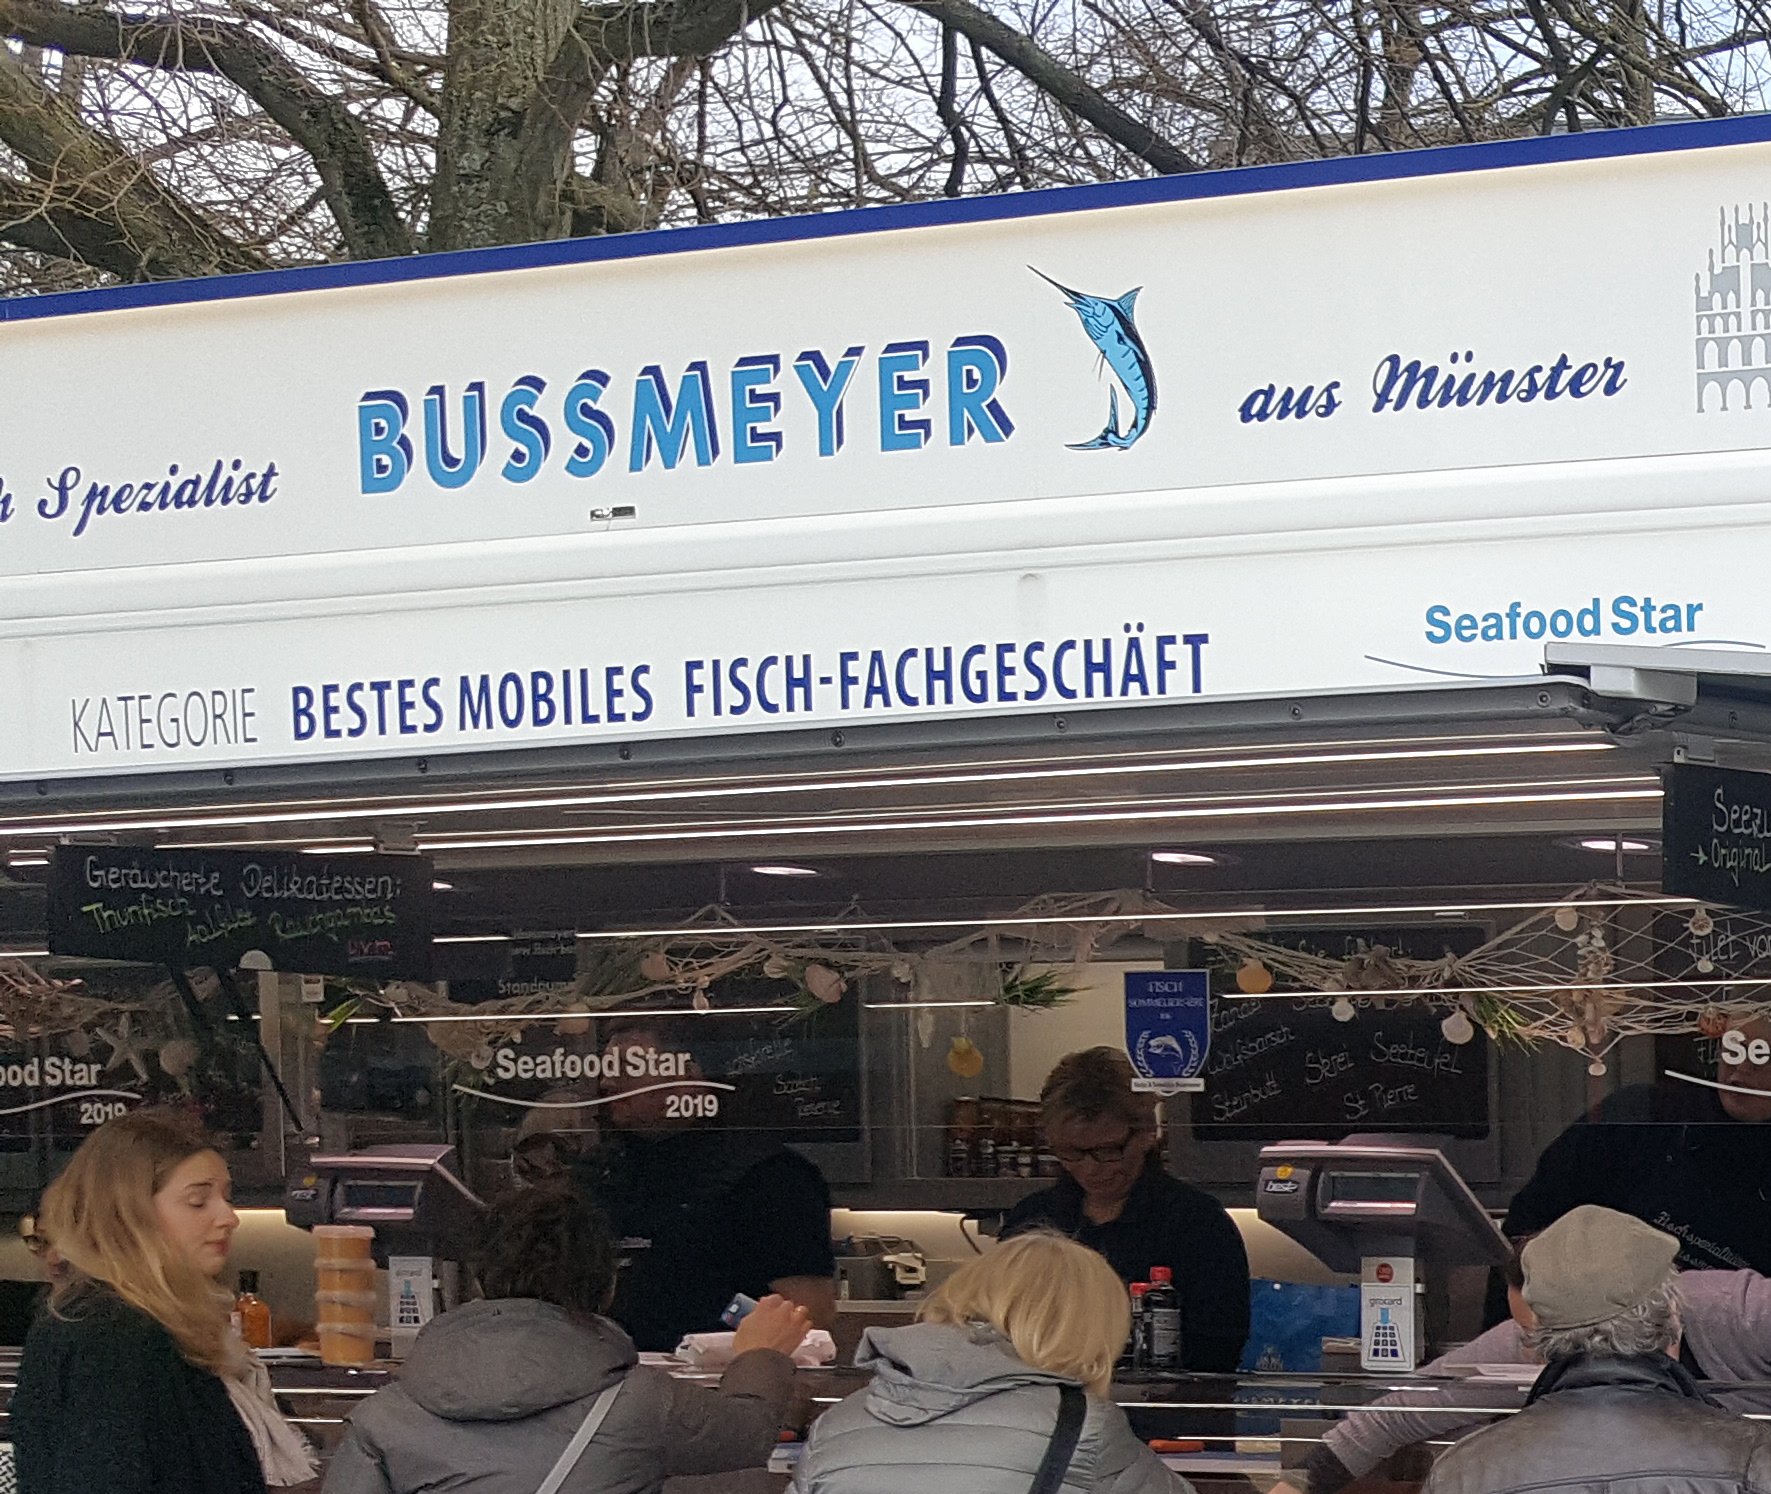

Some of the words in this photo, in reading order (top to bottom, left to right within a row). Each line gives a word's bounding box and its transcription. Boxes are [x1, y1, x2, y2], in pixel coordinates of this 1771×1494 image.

[358, 333, 1016, 495] BUSSMEYER
[1238, 375, 1342, 425] aus
[1371, 350, 1628, 413] Münster
[36, 458, 279, 538] Spezialist
[1424, 597, 1602, 645] Seafood
[1610, 594, 1704, 637] Star
[71, 687, 258, 754] KATEGORIE
[291, 675, 443, 743] BESTES
[458, 662, 654, 732] MOBILES
[684, 622, 1210, 718] FISCH-FACHGESCHÄFT
[44, 1056, 103, 1087] Star
[495, 1045, 621, 1081] Seafood
[625, 1044, 693, 1078] Star
[665, 1093, 720, 1119] 2019
